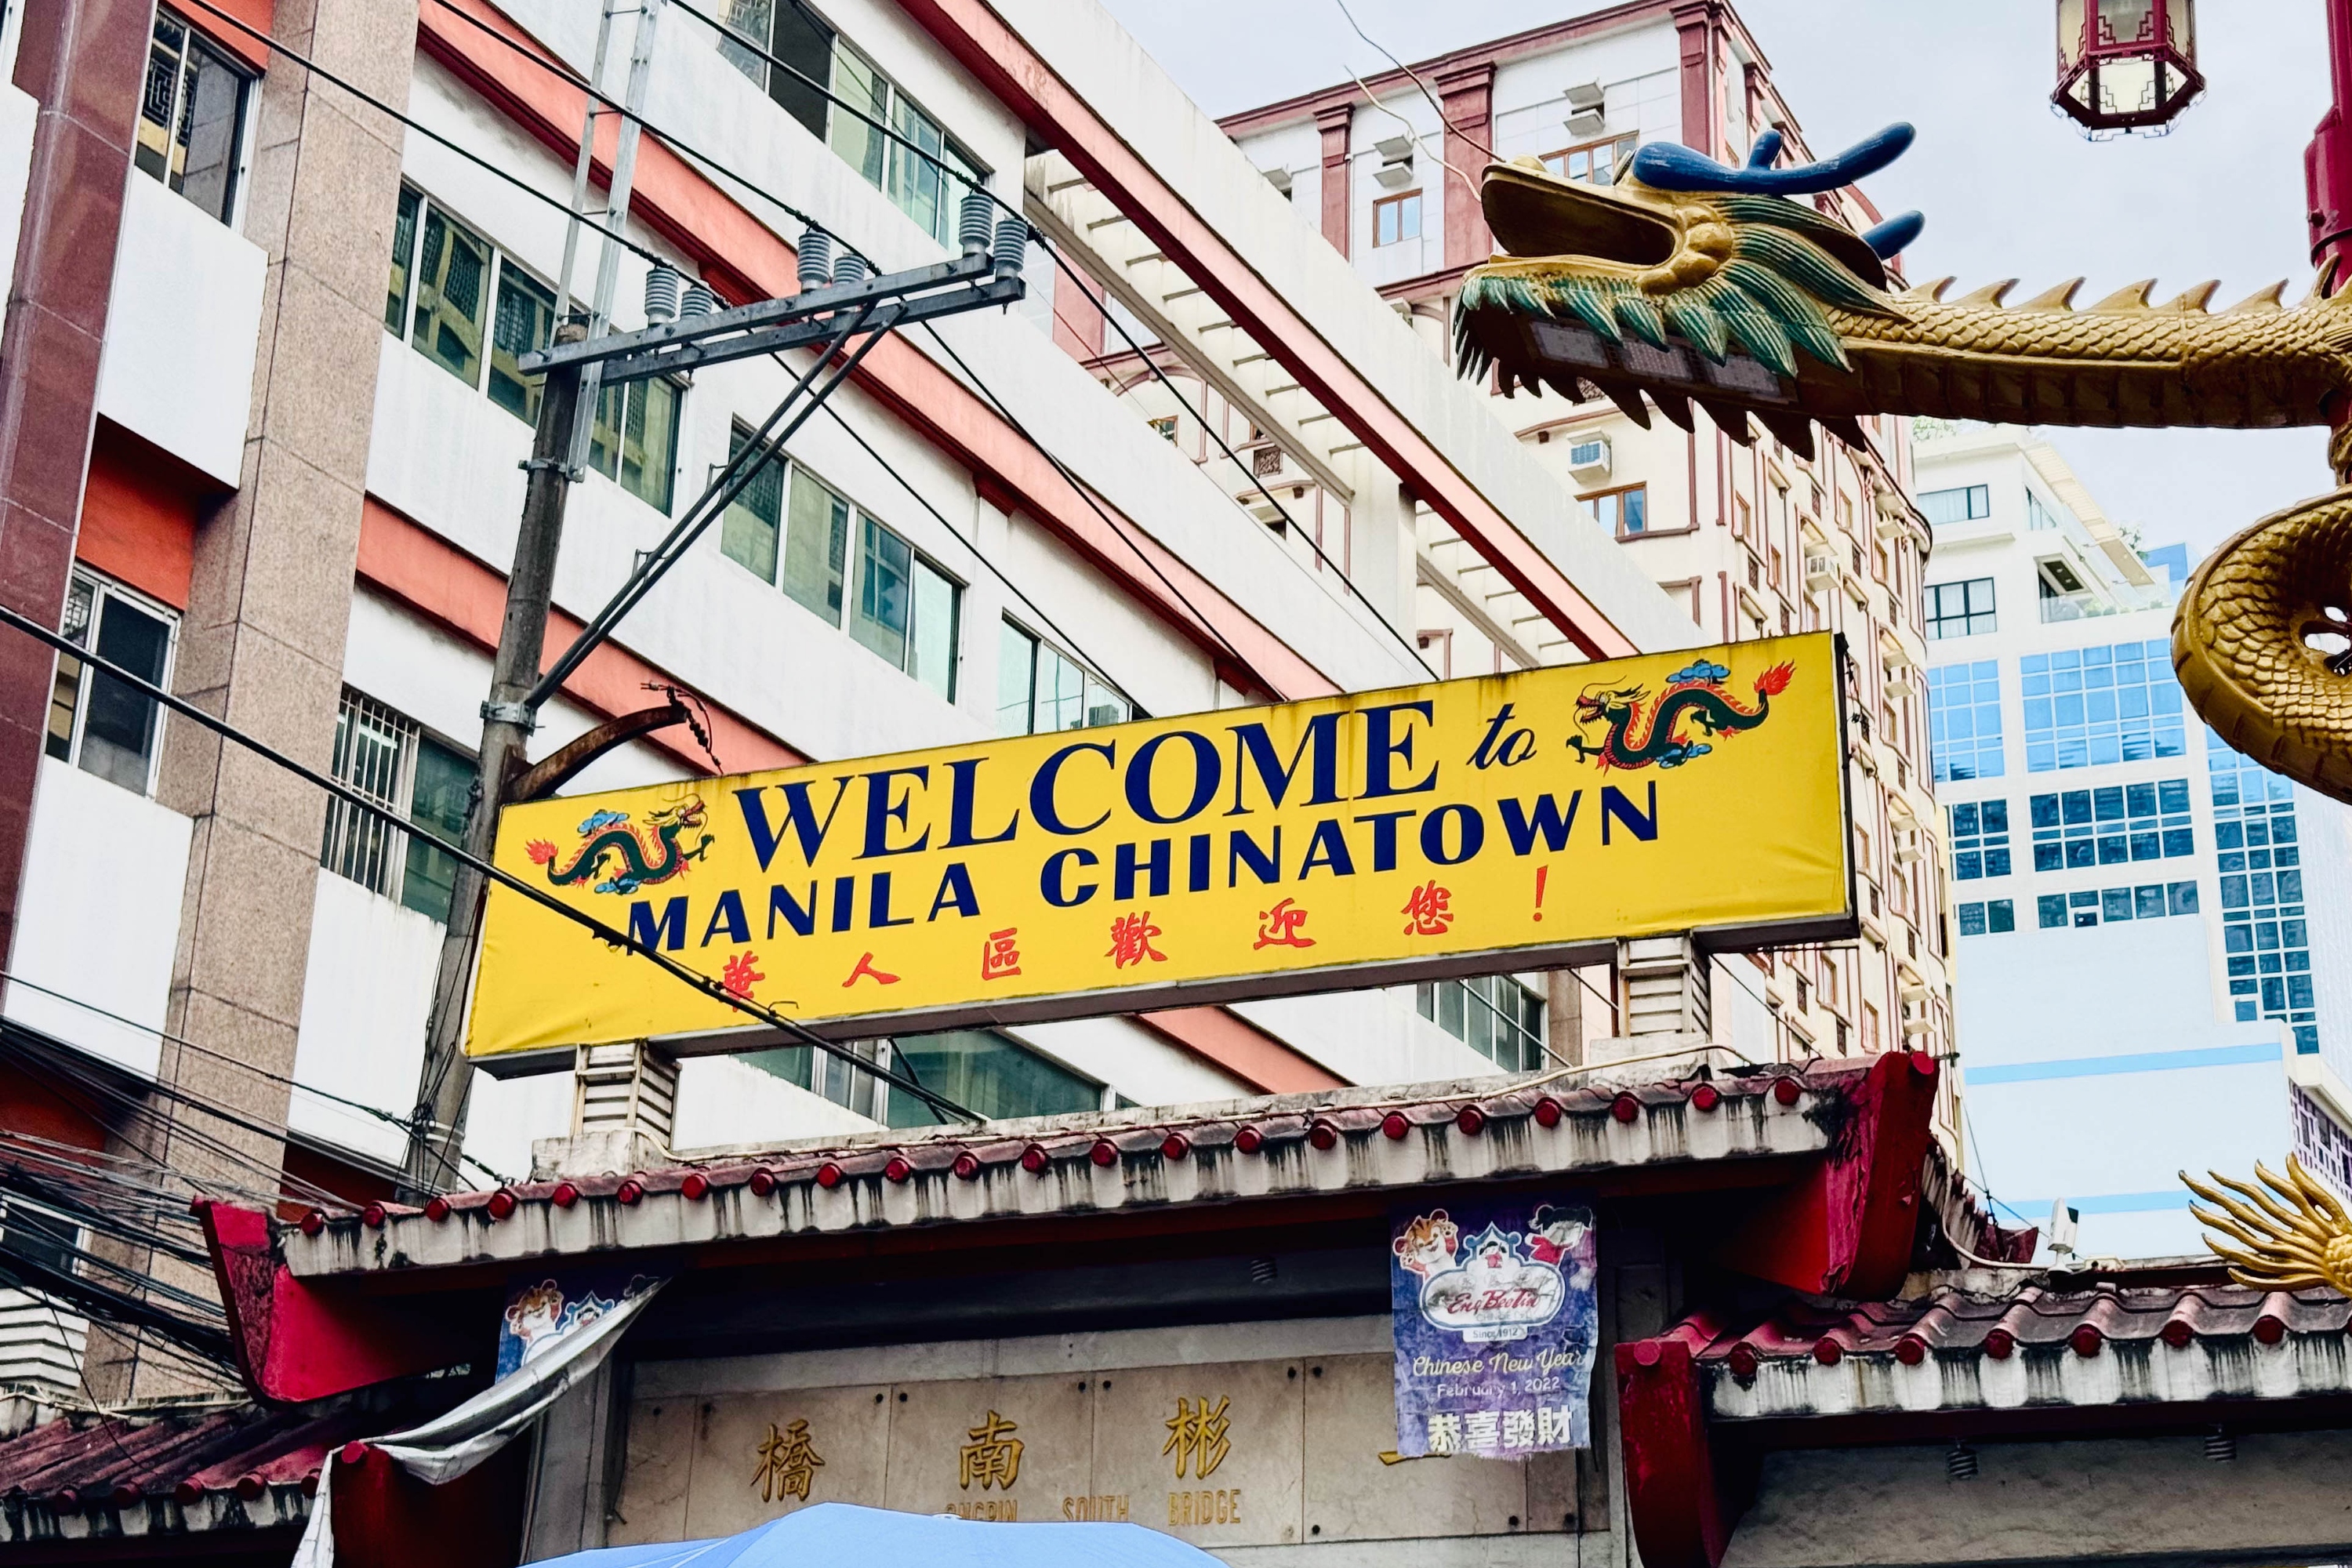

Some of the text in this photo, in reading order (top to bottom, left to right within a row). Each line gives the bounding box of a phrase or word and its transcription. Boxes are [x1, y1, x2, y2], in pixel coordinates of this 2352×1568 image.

[733, 699, 1537, 874] WELCOME to
[626, 780, 1660, 956] MANILA CHINATOWN
[1497, 1327, 1519, 1338] 1912
[1413, 1347, 1584, 1377] Chinese New Year
[1437, 1376, 1561, 1398] February 1, 2022
[1428, 1404, 1573, 1452] 恭喜發財
[1062, 1495, 1130, 1522] SOUTH
[1167, 1489, 1241, 1526] BRIDGE
